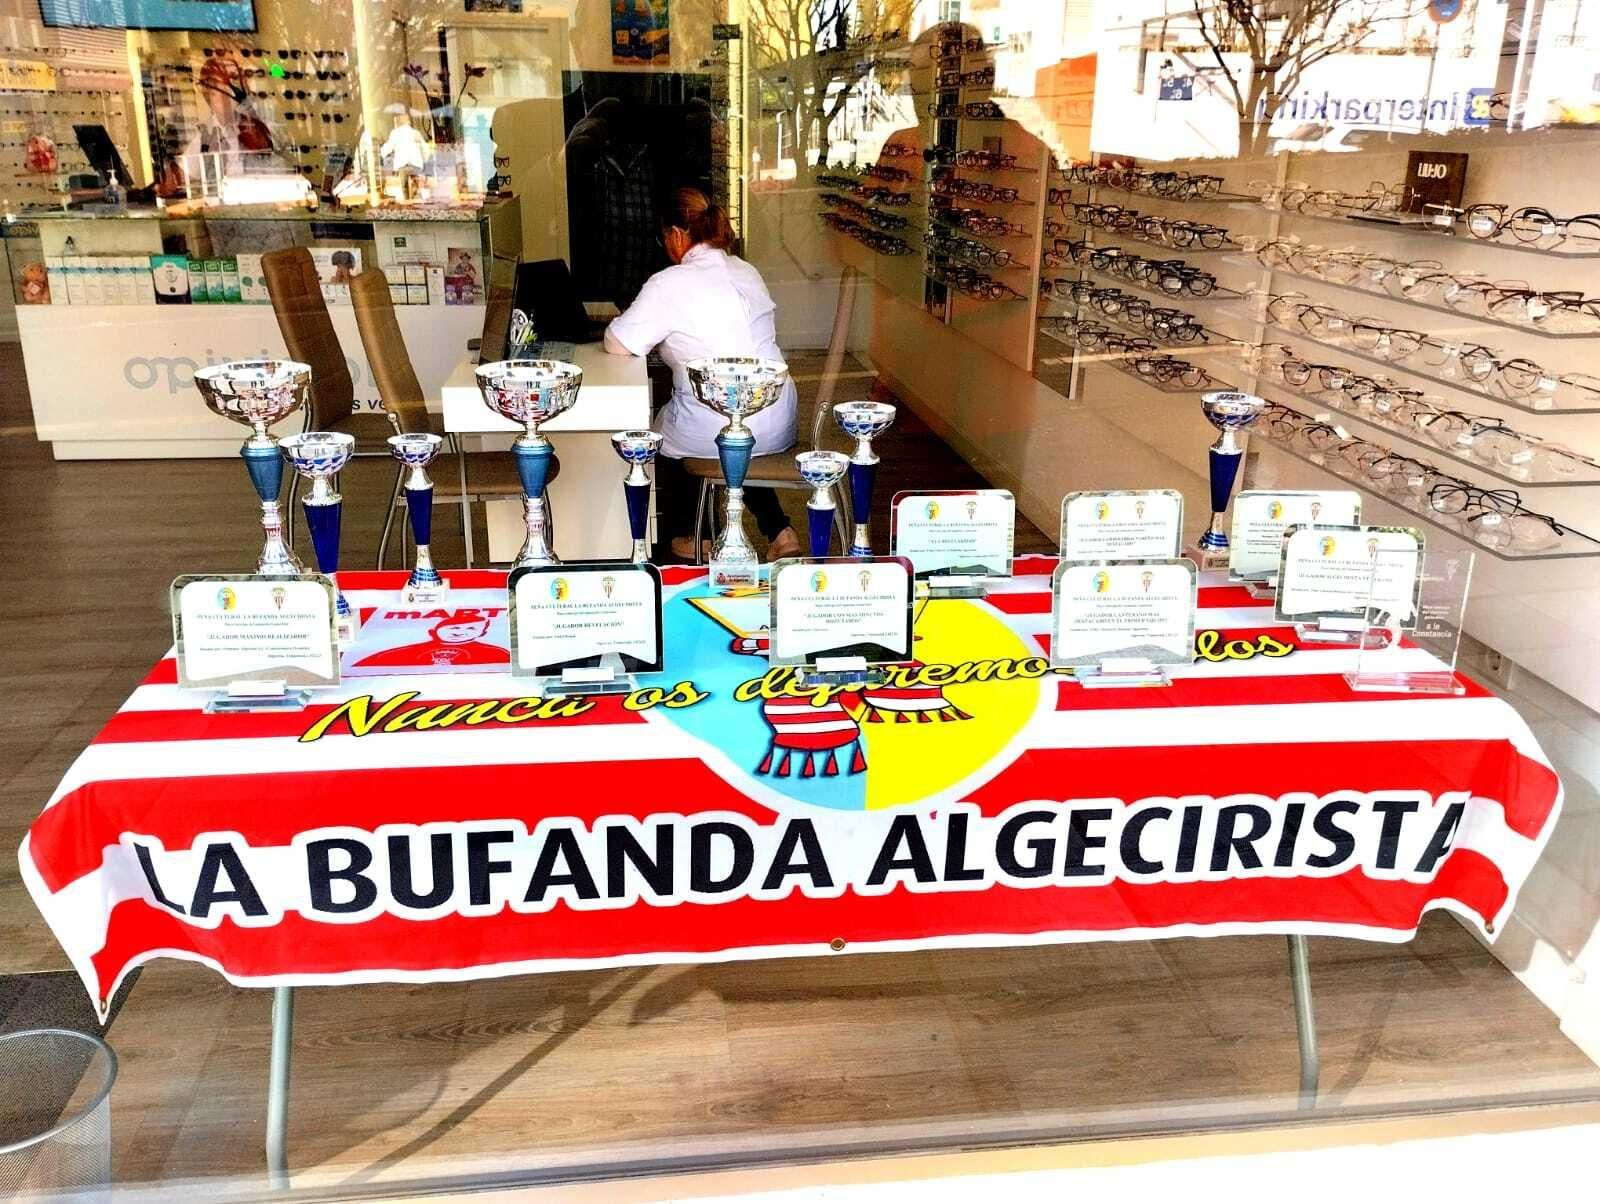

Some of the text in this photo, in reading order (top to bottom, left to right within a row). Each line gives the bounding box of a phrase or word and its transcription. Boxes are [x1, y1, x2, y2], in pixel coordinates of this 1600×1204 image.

[298, 690, 597, 743] Nunca
[621, 679, 712, 712] os
[134, 800, 1468, 918] LA BUFANDA ALGECIRISTA
